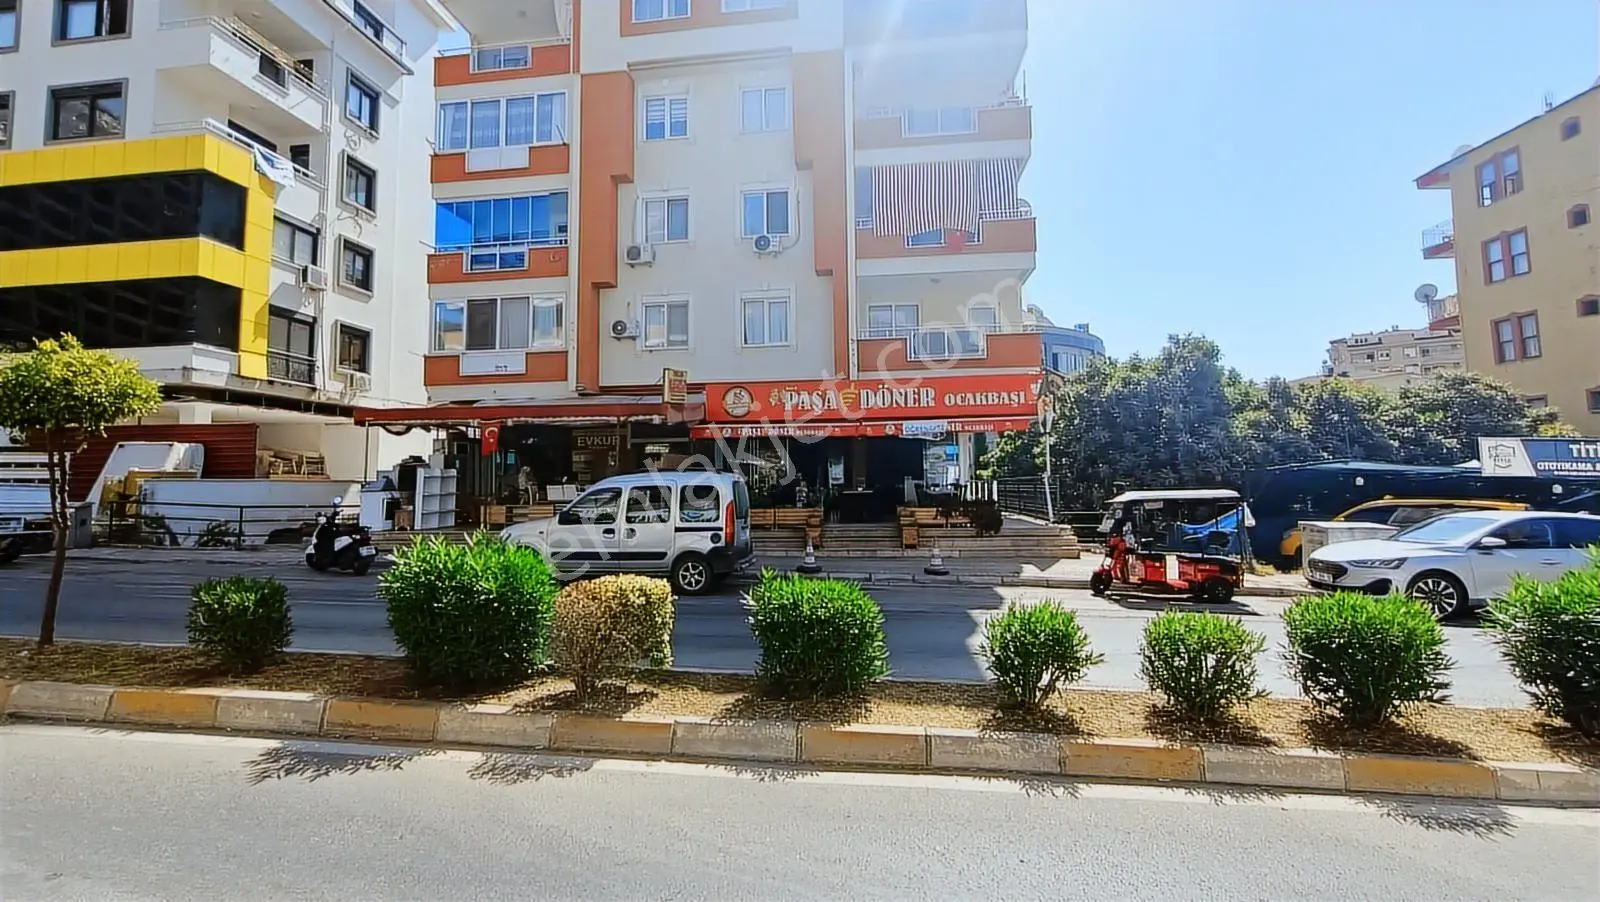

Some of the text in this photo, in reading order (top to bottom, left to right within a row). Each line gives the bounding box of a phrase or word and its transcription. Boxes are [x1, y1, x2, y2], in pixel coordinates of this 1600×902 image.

[785, 384, 1025, 415] PAŞA DÖNER OCAKBAŞI
